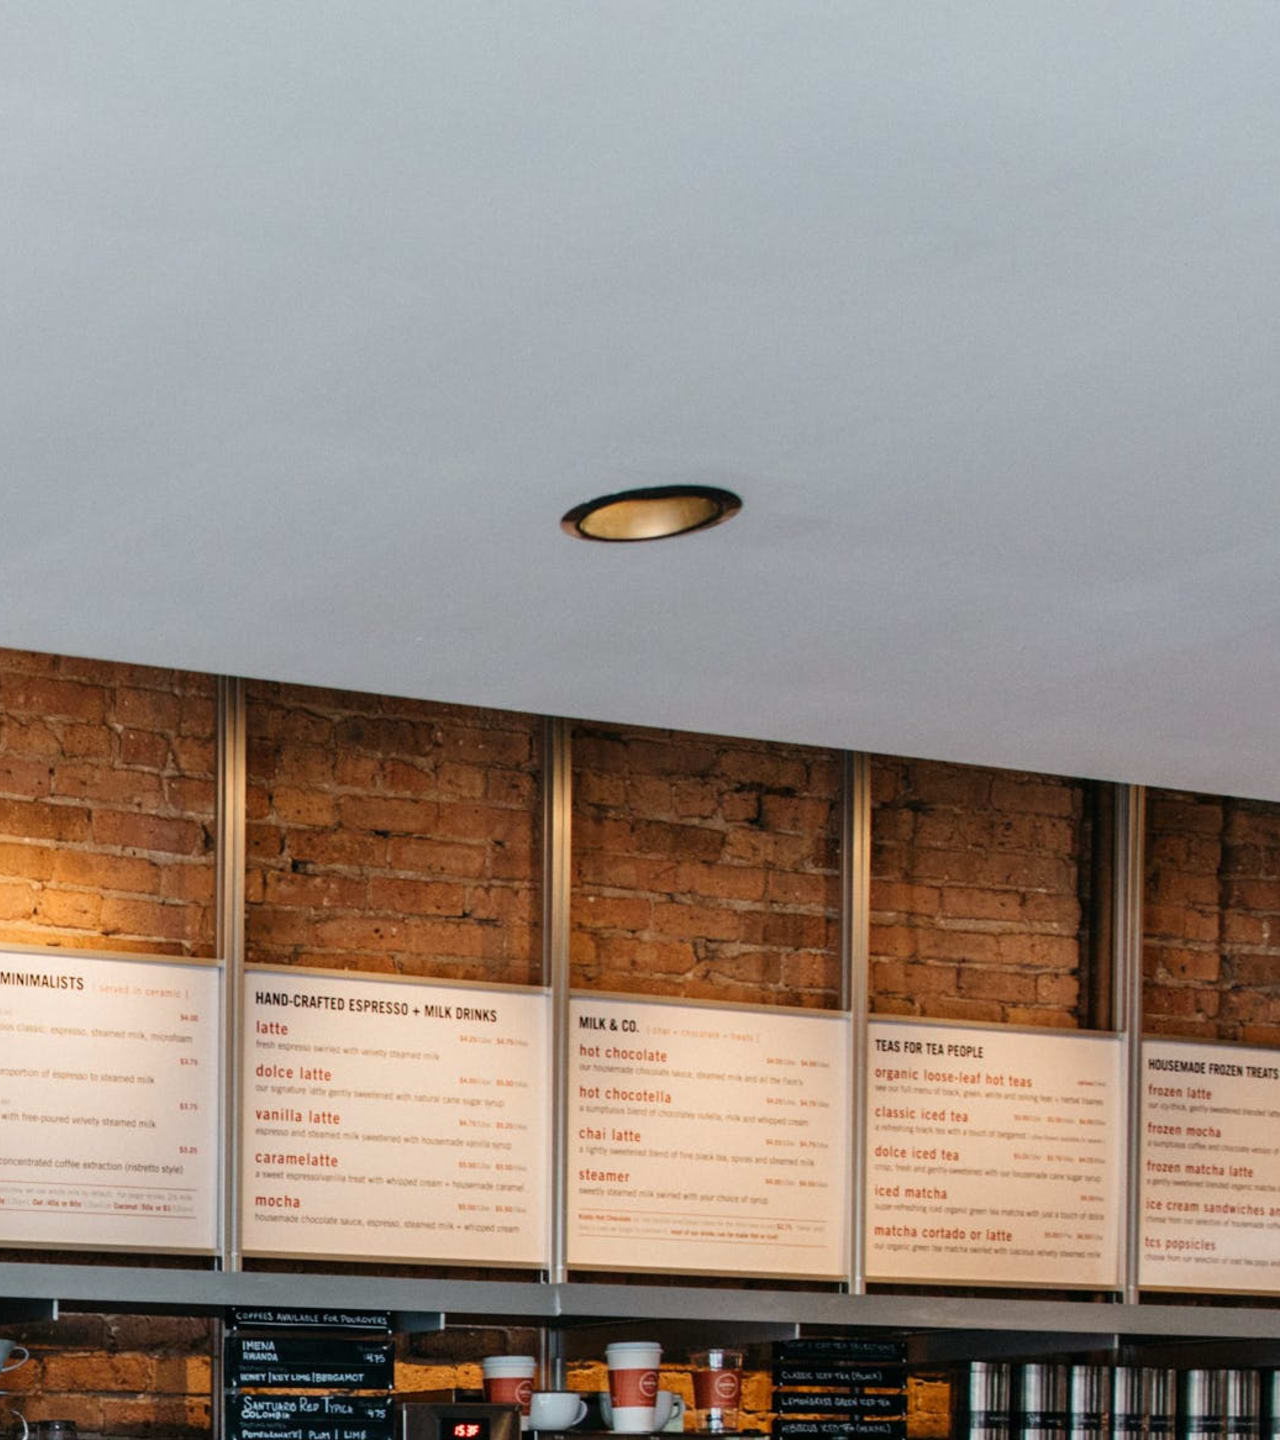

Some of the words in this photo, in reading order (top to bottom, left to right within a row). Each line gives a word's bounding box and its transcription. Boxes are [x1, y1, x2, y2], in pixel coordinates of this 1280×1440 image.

[0, 971, 84, 991] MINIMALISTS
[255, 990, 345, 1011] HAND-CRAFTED
[348, 998, 409, 1016] ESPRESSO
[424, 1004, 452, 1019] MILK
[455, 1006, 497, 1023] DRINKS
[255, 1020, 289, 1036] latte
[578, 1015, 606, 1031] MILK
[609, 1018, 618, 1032] &
[579, 1044, 600, 1058] hot
[604, 1047, 668, 1063] chocolate
[874, 1038, 901, 1053] TEAS
[903, 1040, 923, 1055] FOR
[925, 1042, 945, 1056] TEA
[947, 1044, 983, 1059] PEOPLE
[255, 1064, 294, 1080] dolce
[299, 1066, 332, 1082] latte
[1147, 1058, 1206, 1075] HOUSEMADE
[1208, 1062, 1244, 1077] FROZEN
[873, 1067, 918, 1082] organic
[923, 1071, 981, 1085] loose-leaf
[984, 1073, 1005, 1087] hot
[1007, 1075, 1033, 1089] teas
[578, 1085, 601, 1099] hot
[604, 1087, 672, 1105] chocotella
[255, 1109, 303, 1123] vanilla
[308, 1110, 341, 1125] latte
[578, 1127, 606, 1141] chai
[611, 1130, 641, 1143] latte
[254, 1152, 339, 1168] caramelatte
[579, 1169, 629, 1182] steamer
[254, 1194, 301, 1209] mocha
[873, 1225, 918, 1238] matcha
[921, 1228, 966, 1241] cortado
[970, 1230, 982, 1241] or
[985, 1230, 1013, 1242] latte
